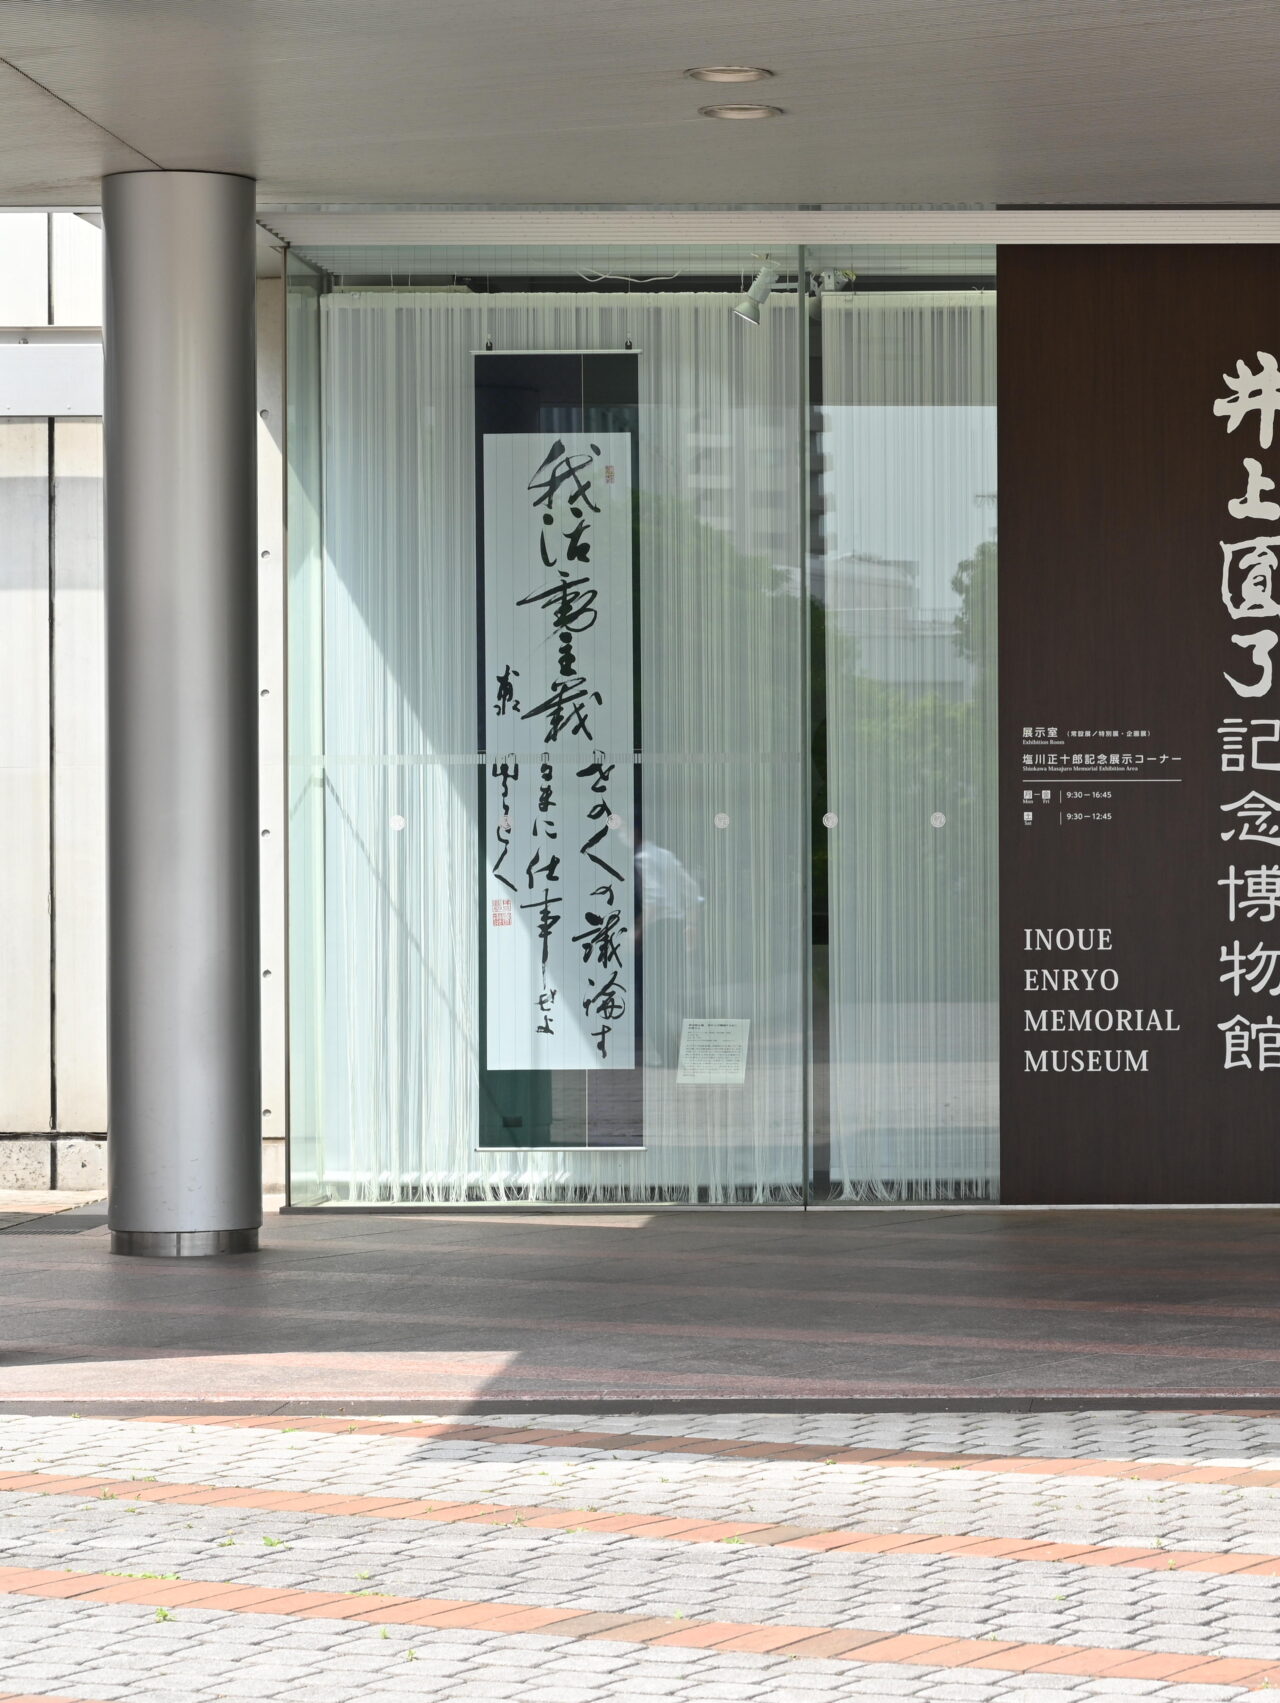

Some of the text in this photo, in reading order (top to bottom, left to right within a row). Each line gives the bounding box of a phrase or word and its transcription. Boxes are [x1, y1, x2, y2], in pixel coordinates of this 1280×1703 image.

[1022, 727, 1058, 738] 展示室
[1022, 753, 1182, 765] 塩川正十郎記念展示コーナー
[1024, 928, 1113, 951] INOUE
[1024, 969, 1119, 991] ENRYO
[1024, 1009, 1180, 1031] MEMORIAL
[1024, 1050, 1149, 1072] MUSEUM
